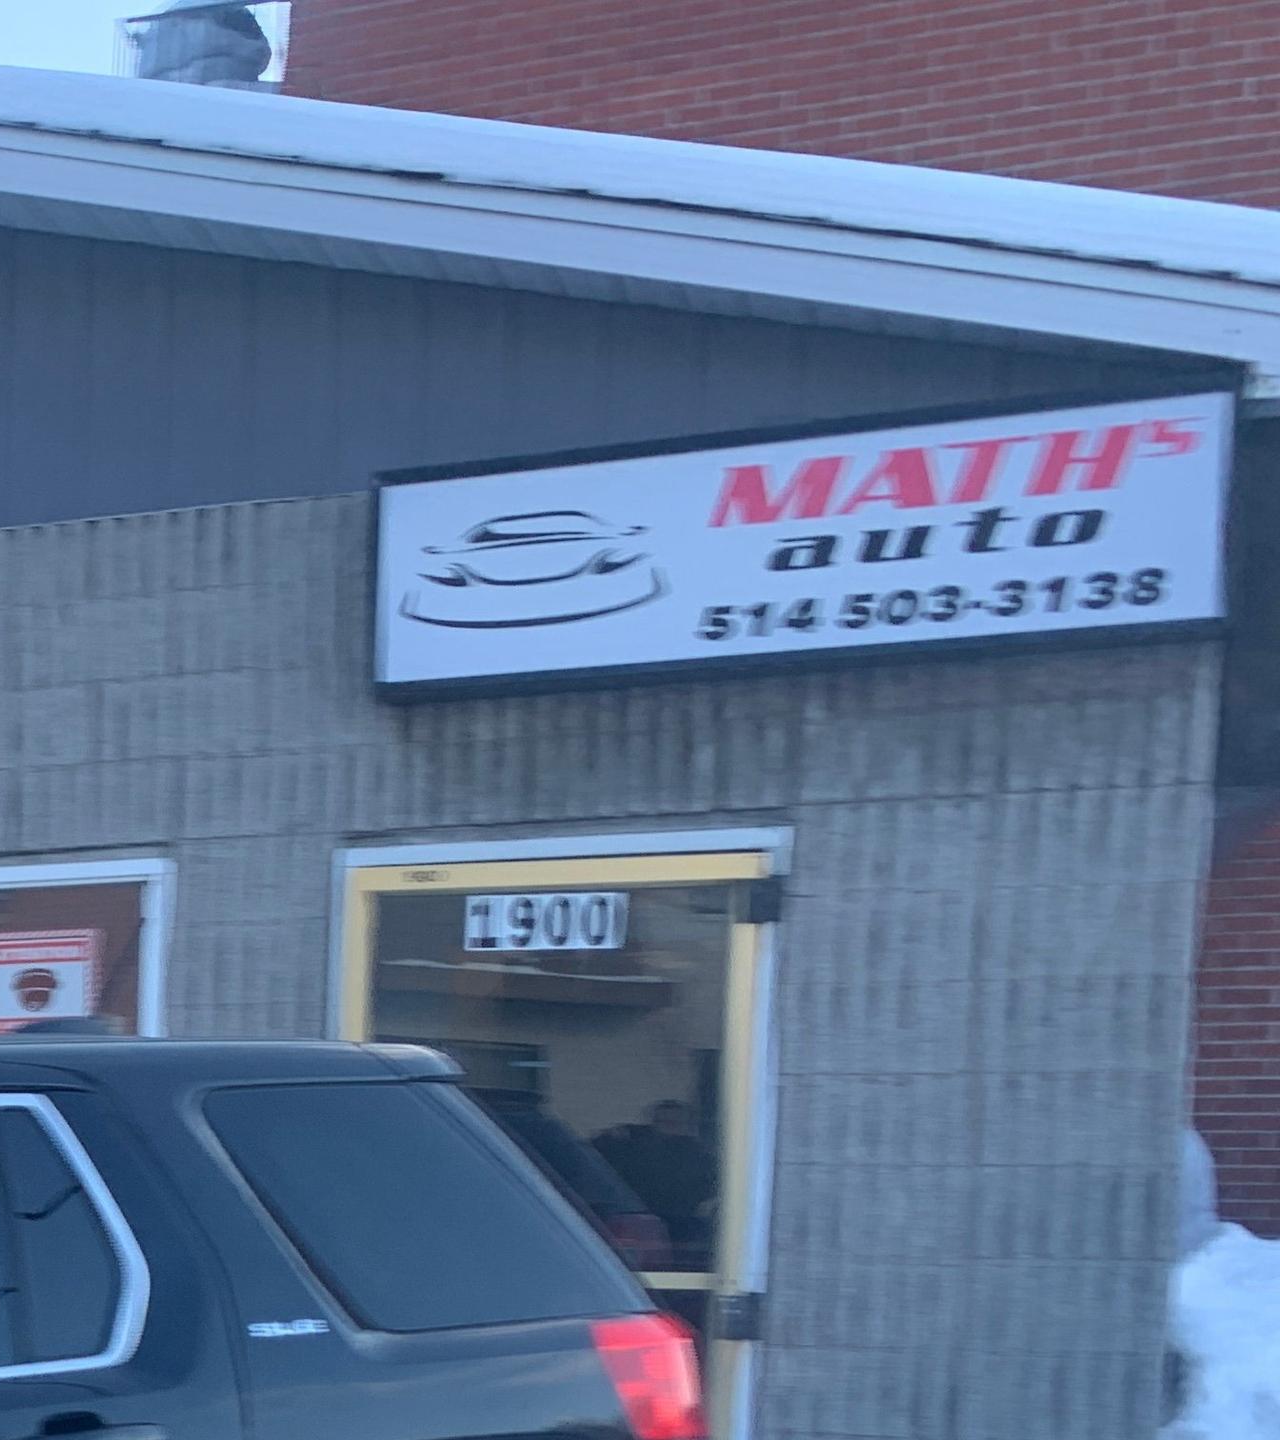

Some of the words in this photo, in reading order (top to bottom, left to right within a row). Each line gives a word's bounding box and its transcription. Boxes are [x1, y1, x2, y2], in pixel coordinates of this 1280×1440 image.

[765, 505, 1107, 573] auto
[695, 599, 828, 642] 514
[839, 566, 1172, 632] 503-3138
[468, 896, 615, 949] 1900
